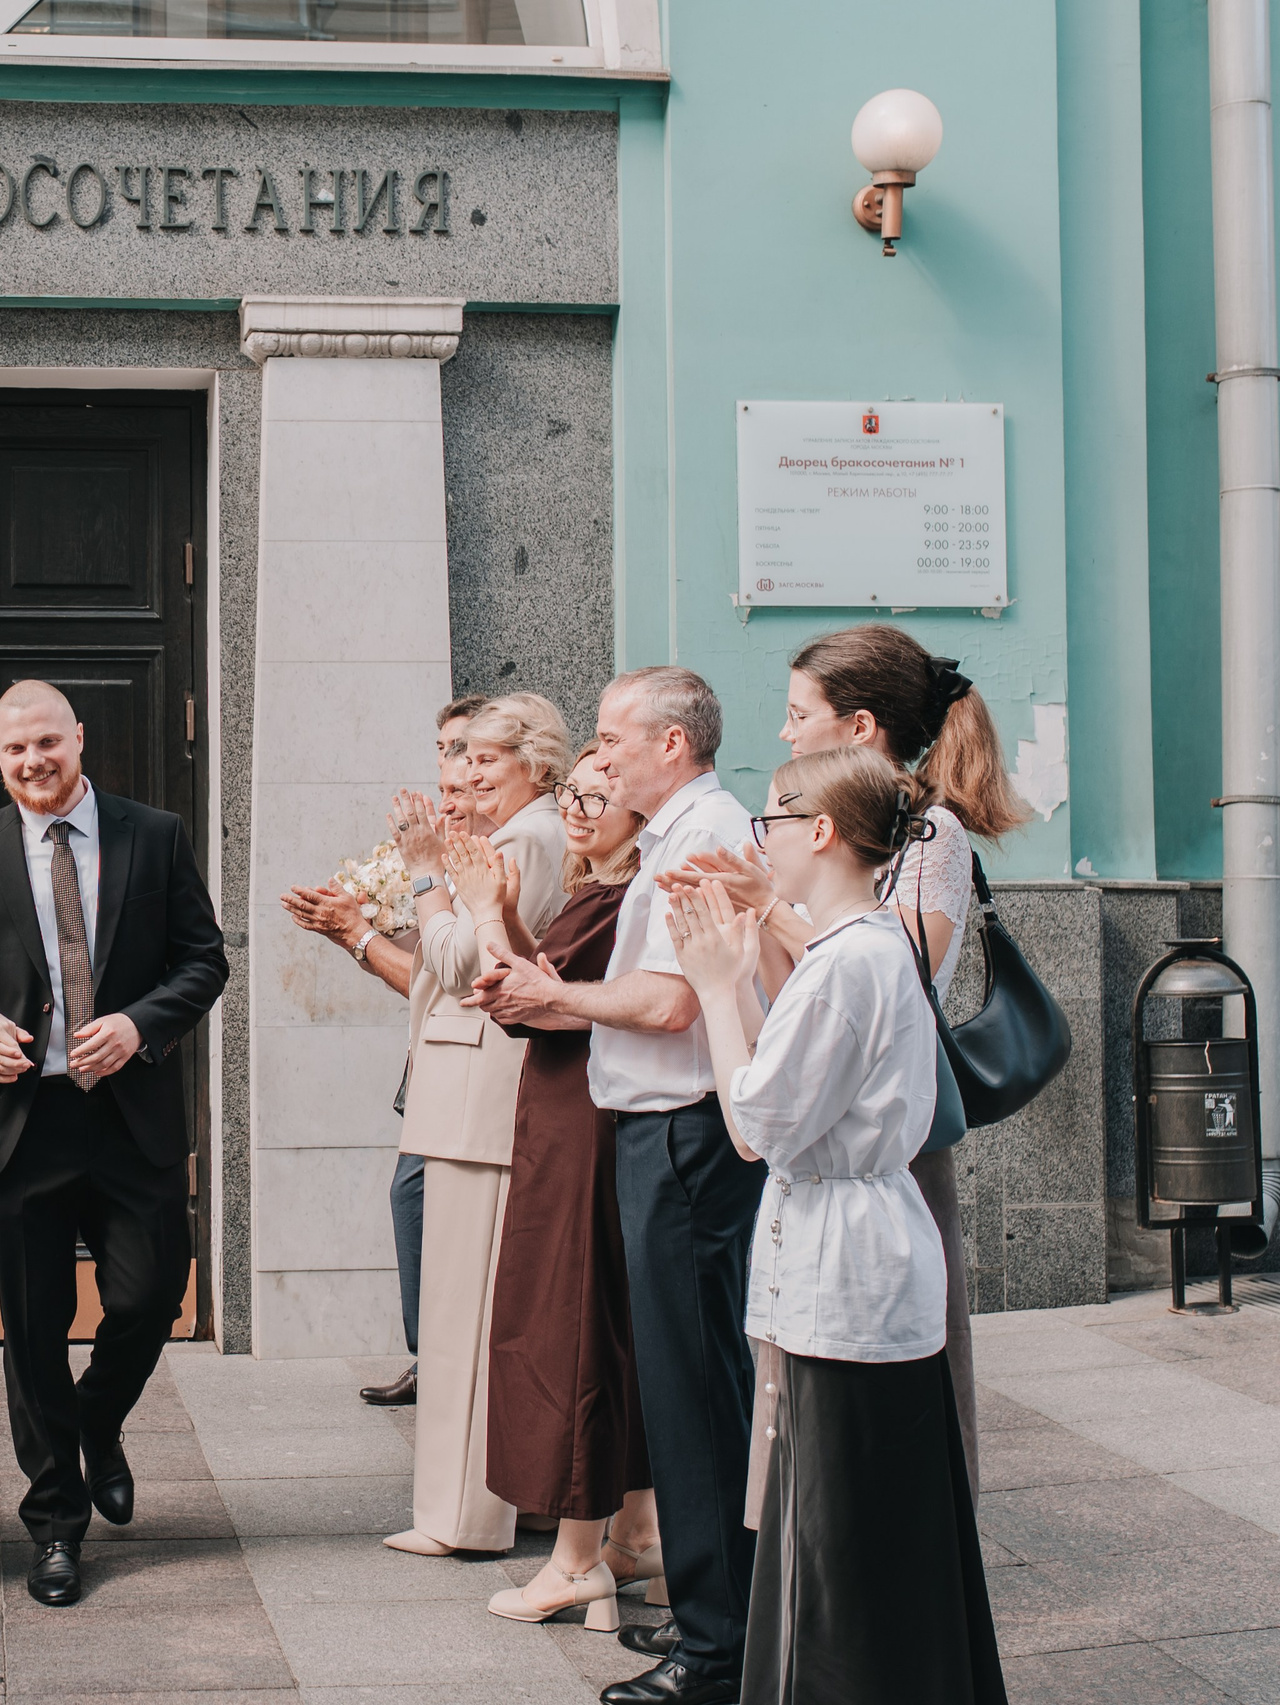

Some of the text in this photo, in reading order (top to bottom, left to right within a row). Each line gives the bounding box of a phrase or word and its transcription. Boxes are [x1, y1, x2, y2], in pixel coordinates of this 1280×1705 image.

[778, 456, 828, 470] Дворец
[831, 456, 936, 470] бракосочетания
[959, 458, 964, 468] 1
[827, 487, 917, 498] РЕЖИМ РАБОТЫ
[923, 504, 949, 515] 9:00
[960, 504, 989, 515] 18:00
[924, 522, 949, 532] 9:00
[958, 522, 989, 533] 20:00
[924, 539, 949, 550] 9:00
[958, 539, 990, 550] 23:59
[917, 557, 949, 568] 00:00
[960, 557, 990, 568] 19:00
